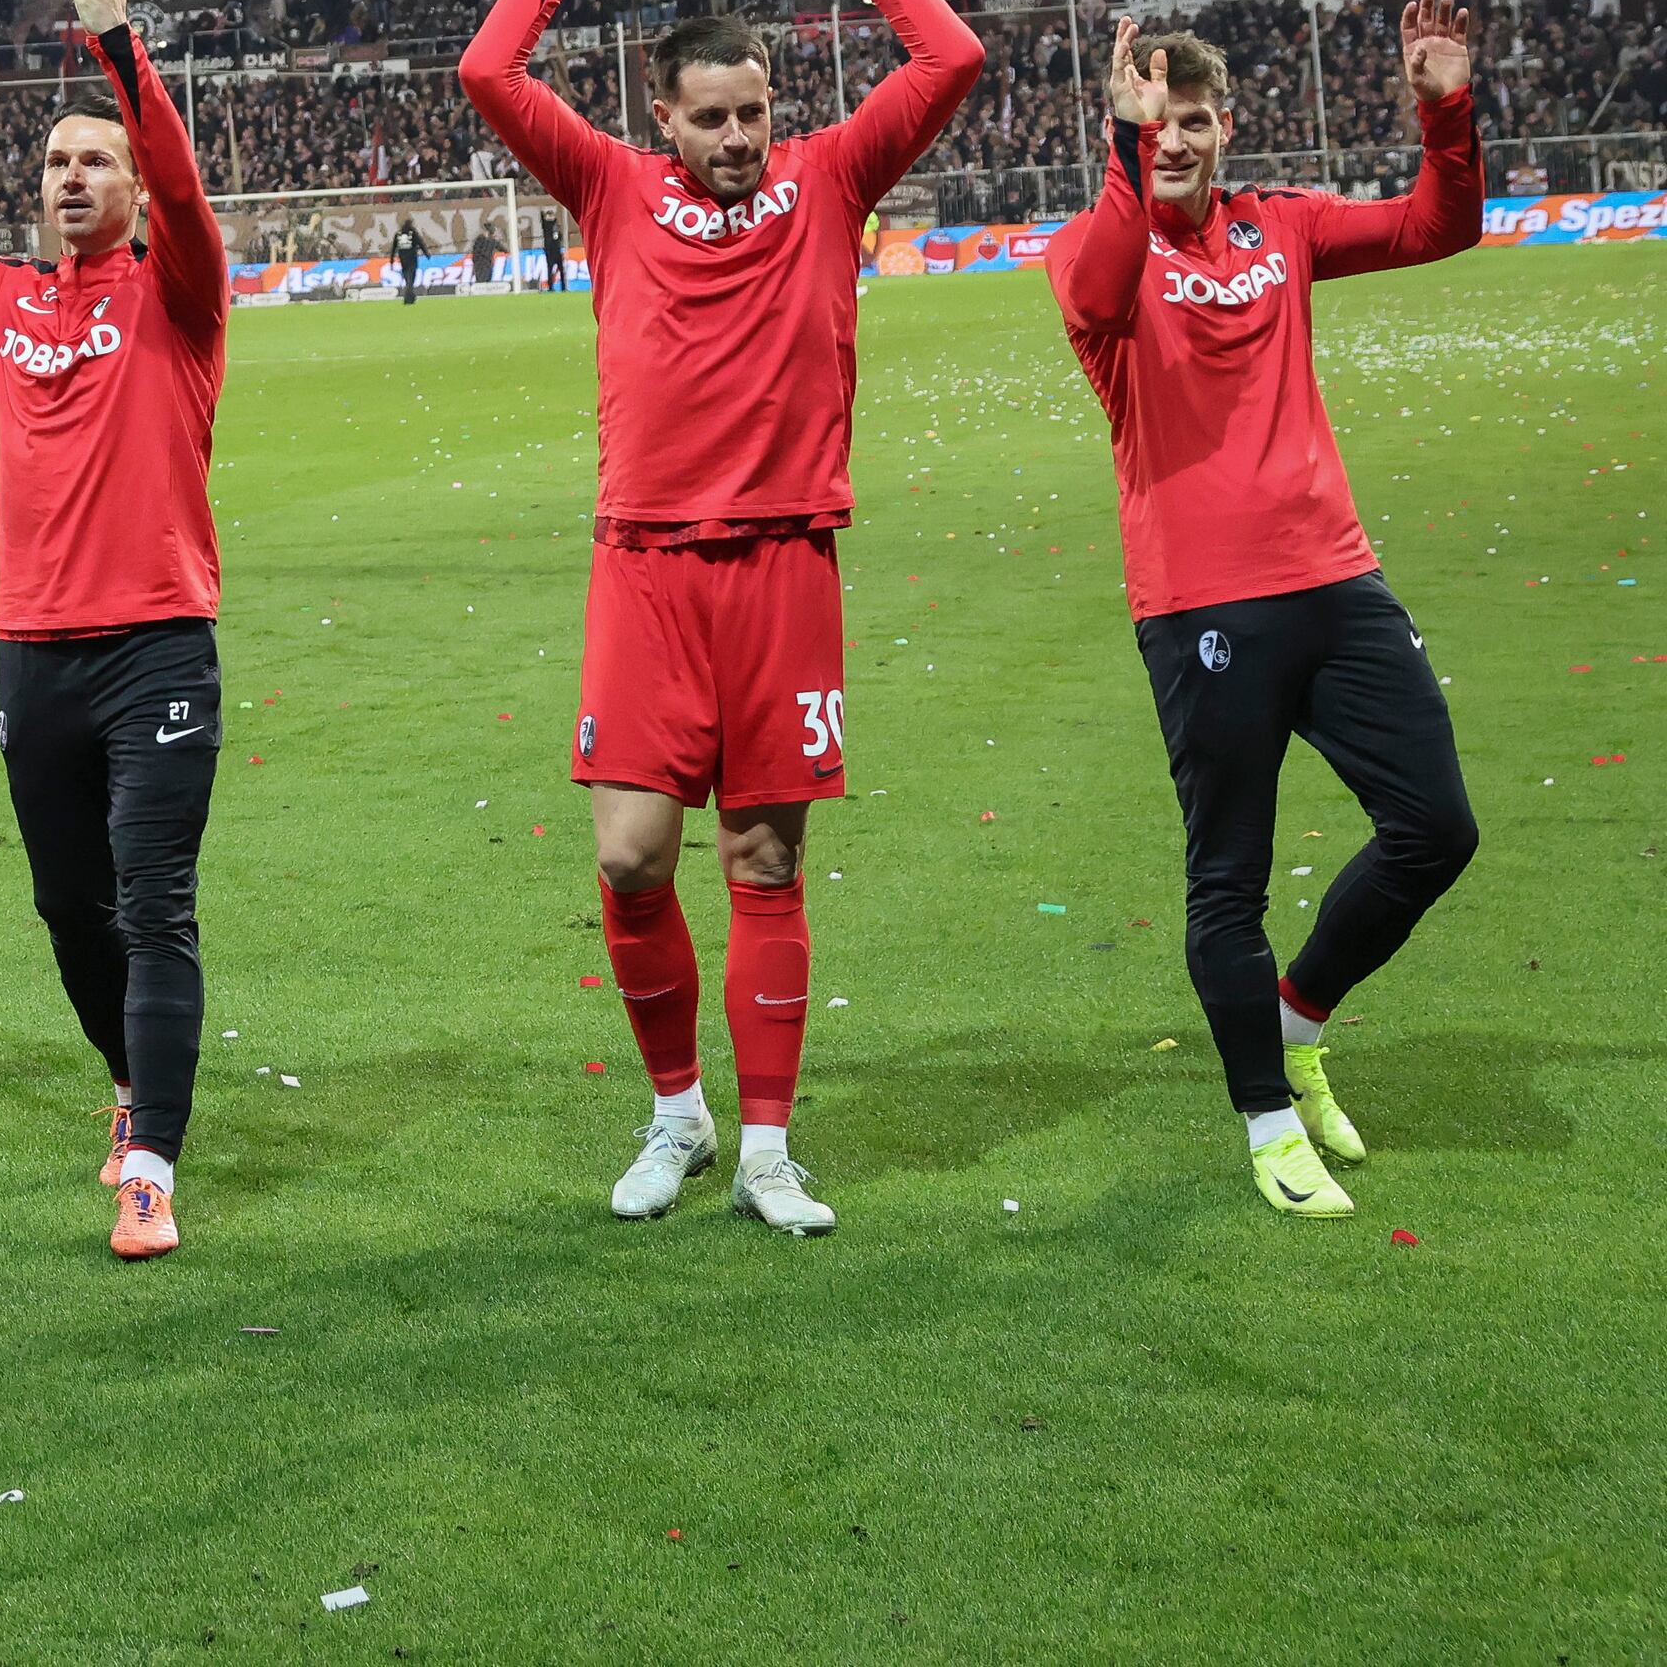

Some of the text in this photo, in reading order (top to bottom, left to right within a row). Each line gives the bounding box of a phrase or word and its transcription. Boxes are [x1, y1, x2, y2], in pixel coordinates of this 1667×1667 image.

[652, 180, 799, 241] JOBRAD
[1162, 252, 1287, 306] JOBRAD
[0, 323, 122, 375] JOBRAD
[169, 700, 190, 721] 27
[795, 688, 844, 757] 30
